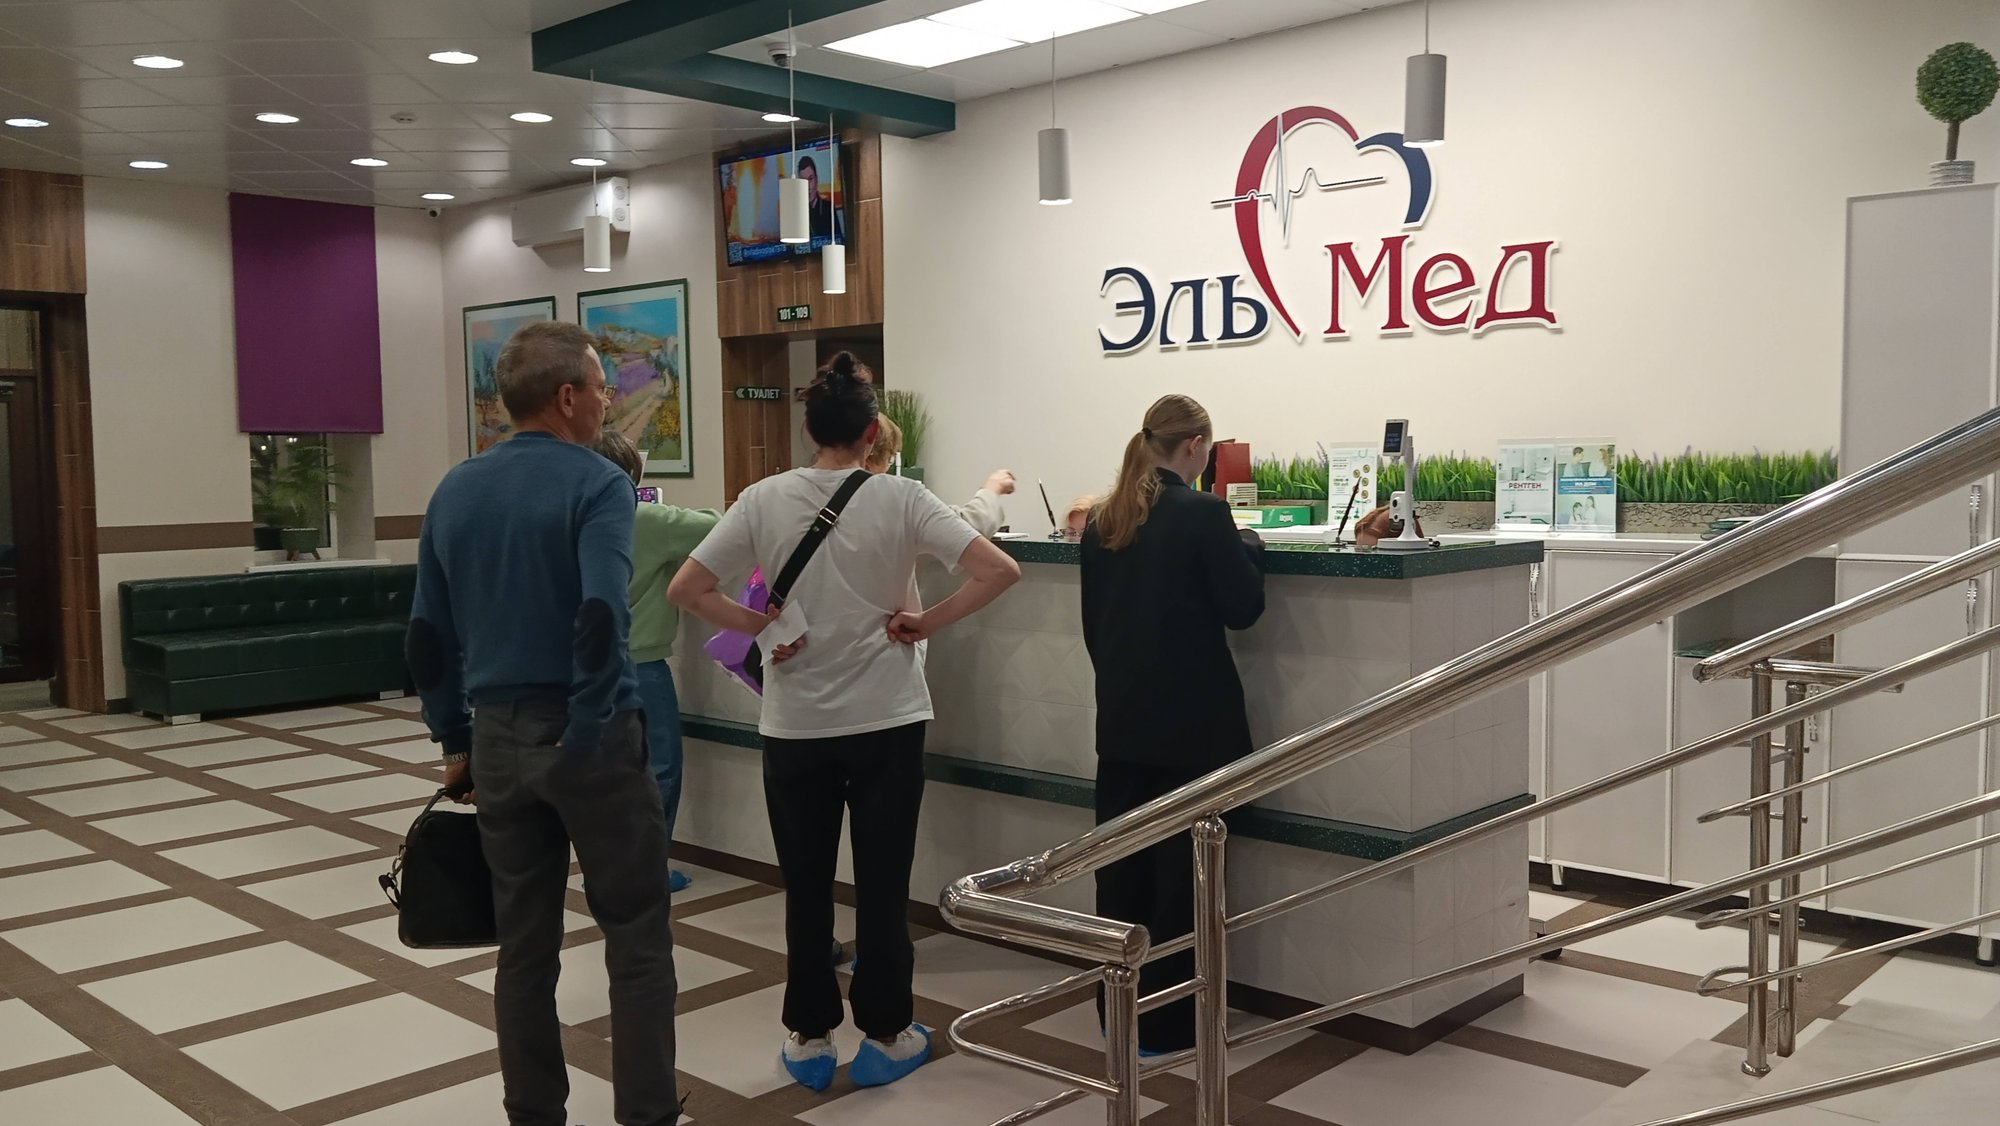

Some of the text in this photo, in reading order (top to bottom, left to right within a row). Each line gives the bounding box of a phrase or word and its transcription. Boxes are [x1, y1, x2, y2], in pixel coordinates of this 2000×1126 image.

[1098, 234, 1559, 352] Эль Мед
[747, 388, 781, 399] ТУАЛЕТ
